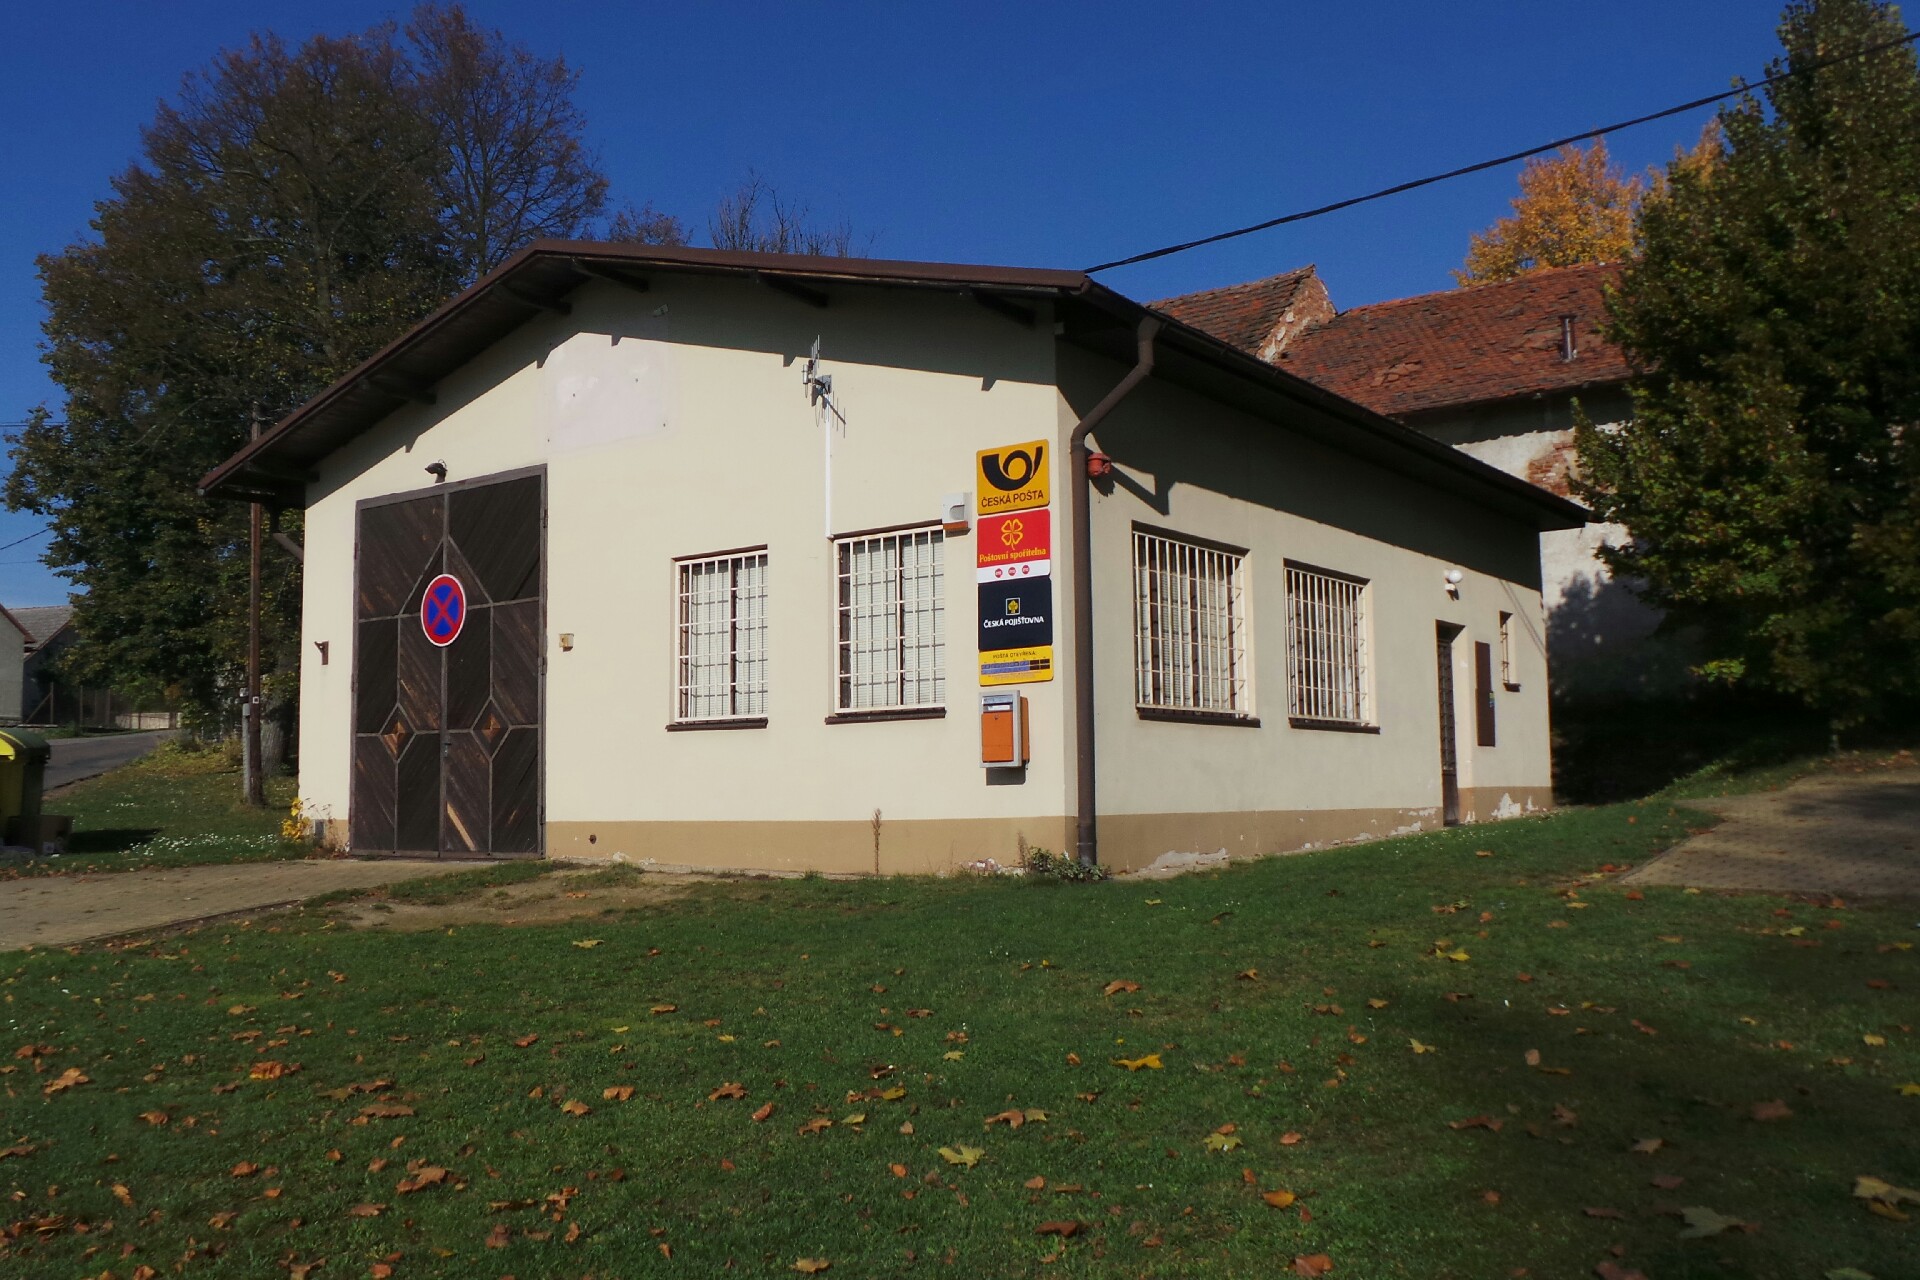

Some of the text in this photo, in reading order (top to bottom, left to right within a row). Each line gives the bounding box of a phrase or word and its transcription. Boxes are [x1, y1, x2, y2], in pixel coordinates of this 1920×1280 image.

[981, 490, 1044, 507] ČESKÁ POŠTA
[979, 547, 1046, 563] Poštovní spořitelna
[983, 616, 1044, 628] ČESKÁ POJIŠŤOVNA
